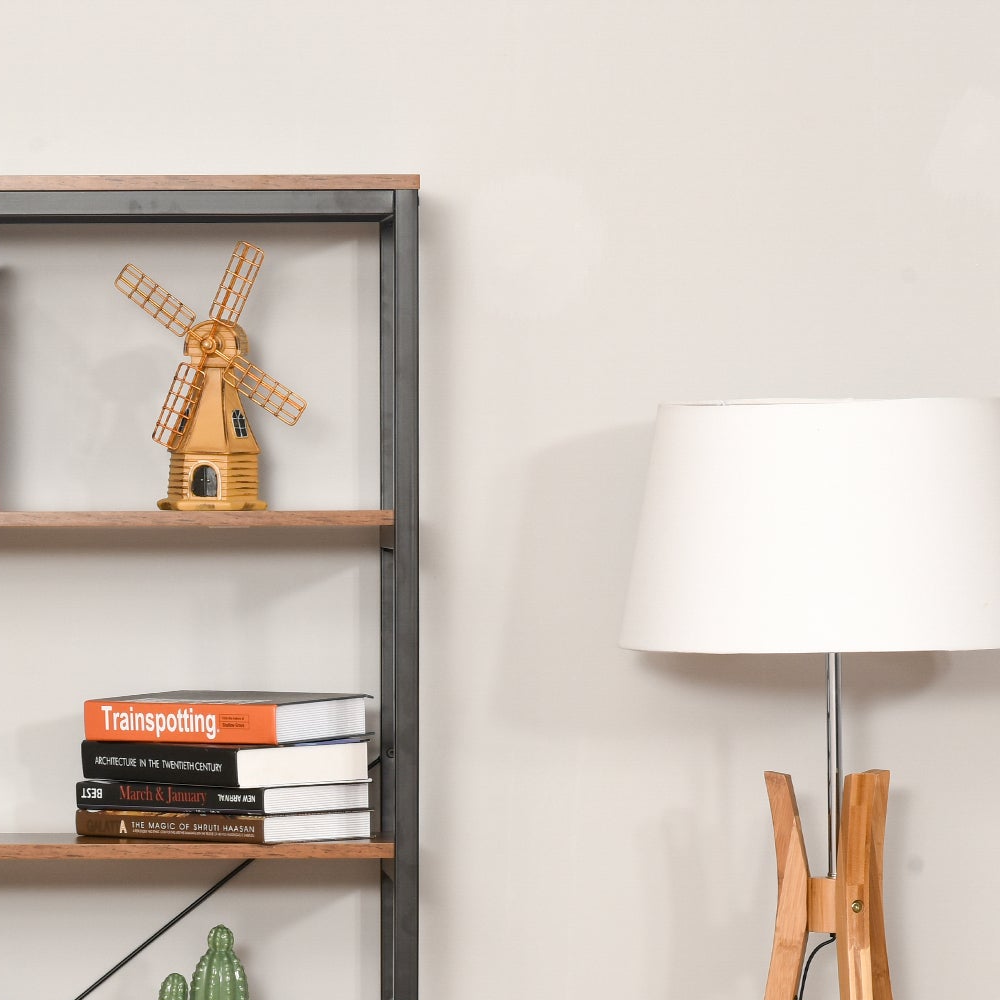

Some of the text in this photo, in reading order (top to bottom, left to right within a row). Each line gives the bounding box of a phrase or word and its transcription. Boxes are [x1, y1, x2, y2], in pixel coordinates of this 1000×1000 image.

[95, 756, 222, 773] ARCHITECTURE IN THE TWENTIETH CENTURY
[81, 788, 103, 799] BEST
[119, 785, 208, 805] March & January
[217, 793, 256, 802] NEW ARRIVAL
[148, 822, 178, 831] MAGIC
[178, 823, 190, 831] OF
[193, 824, 220, 832] SHRUTI
